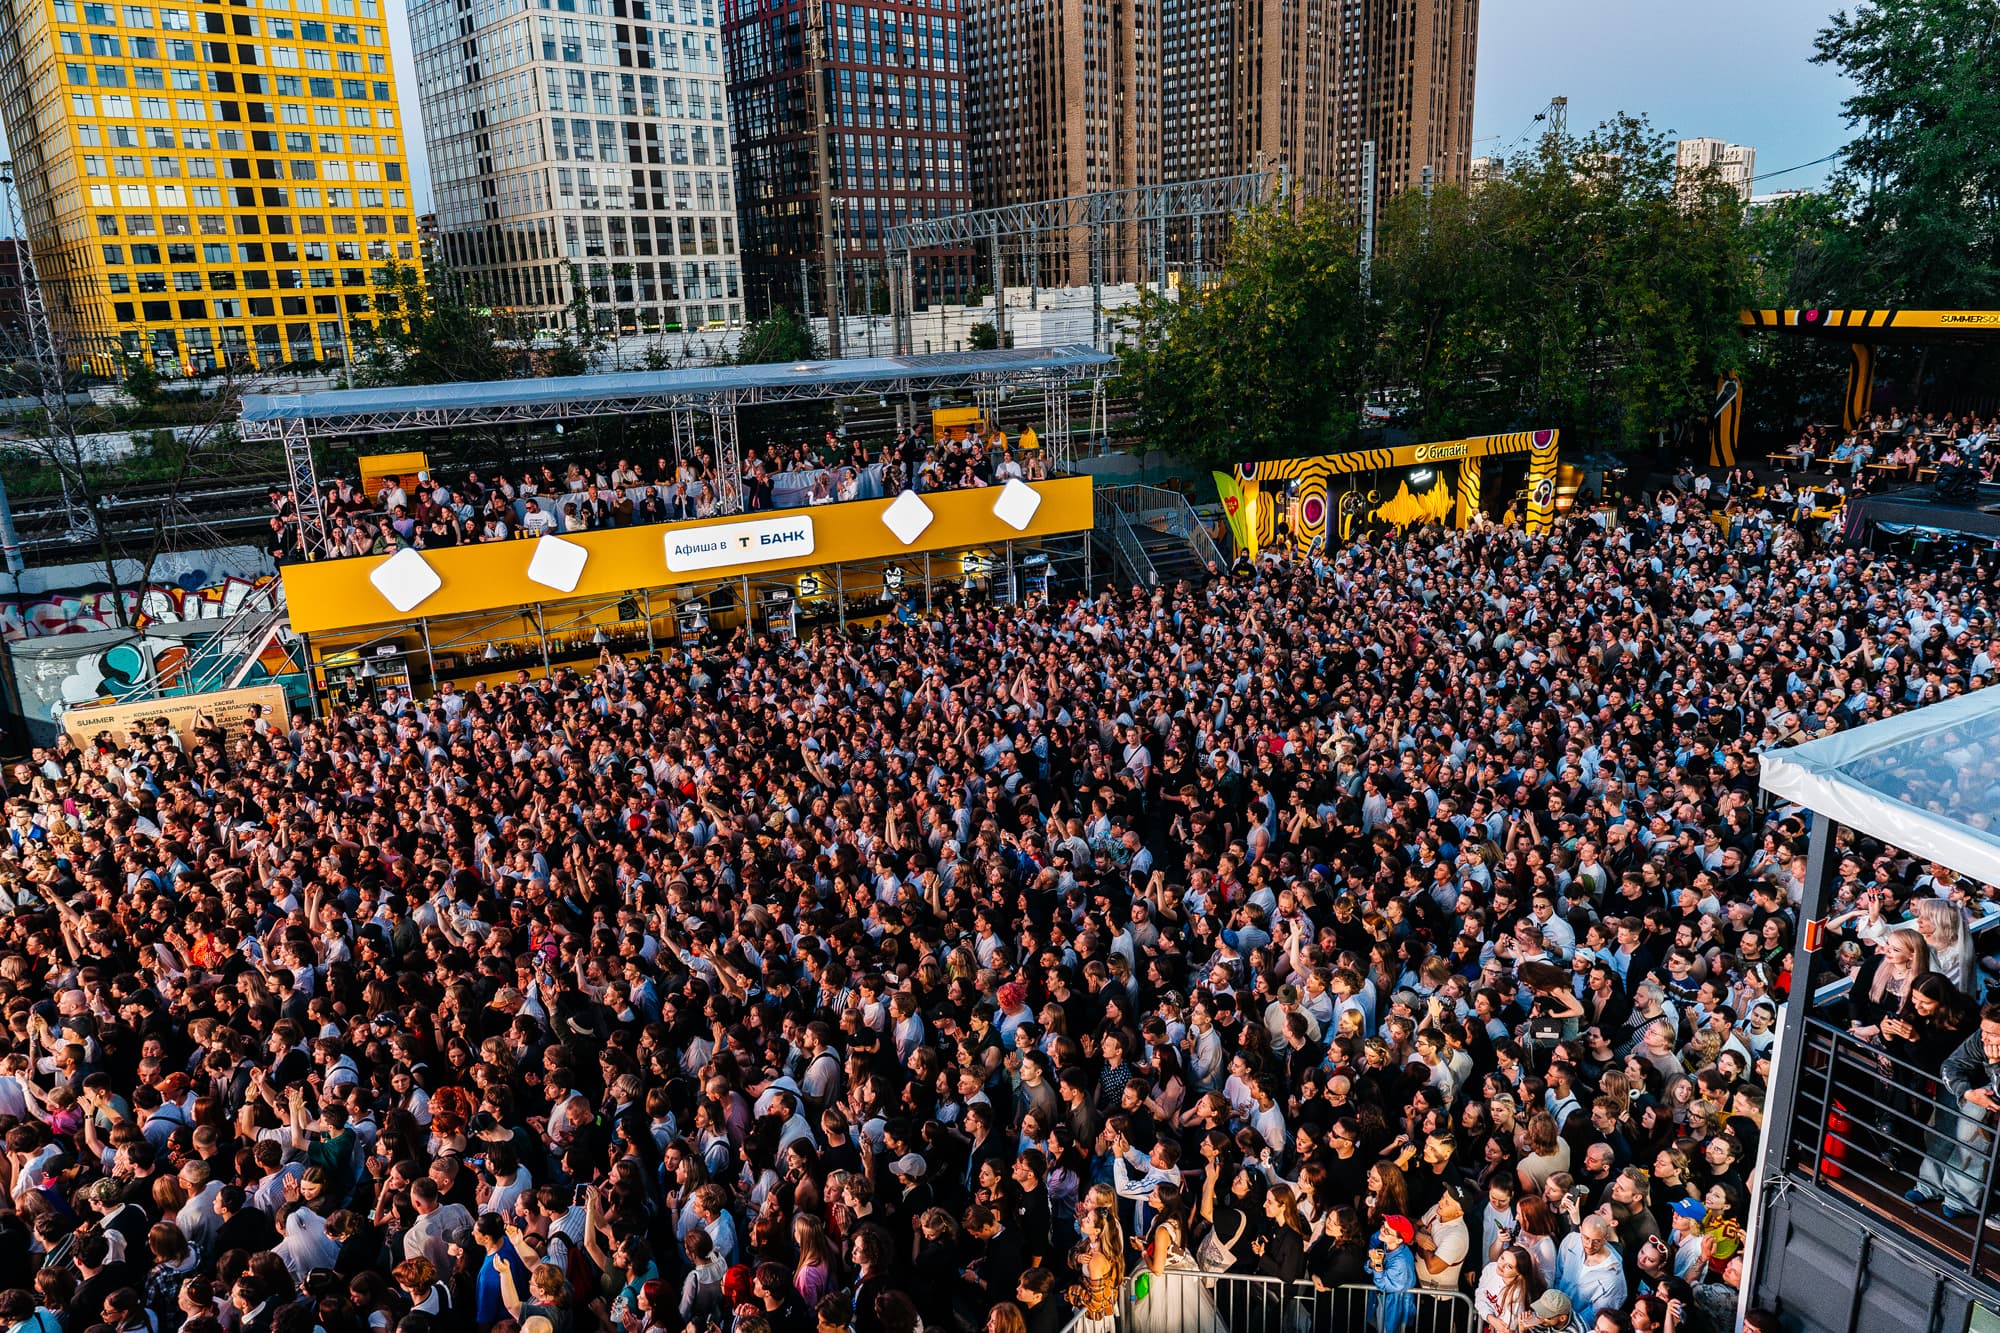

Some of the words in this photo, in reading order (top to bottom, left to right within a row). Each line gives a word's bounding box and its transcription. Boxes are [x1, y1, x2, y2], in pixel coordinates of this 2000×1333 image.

[1429, 444, 1469, 459] билайн
[674, 541, 718, 556] Афиша
[720, 540, 728, 550] в
[760, 530, 805, 546] БАНК
[76, 716, 115, 727] SUMMER
